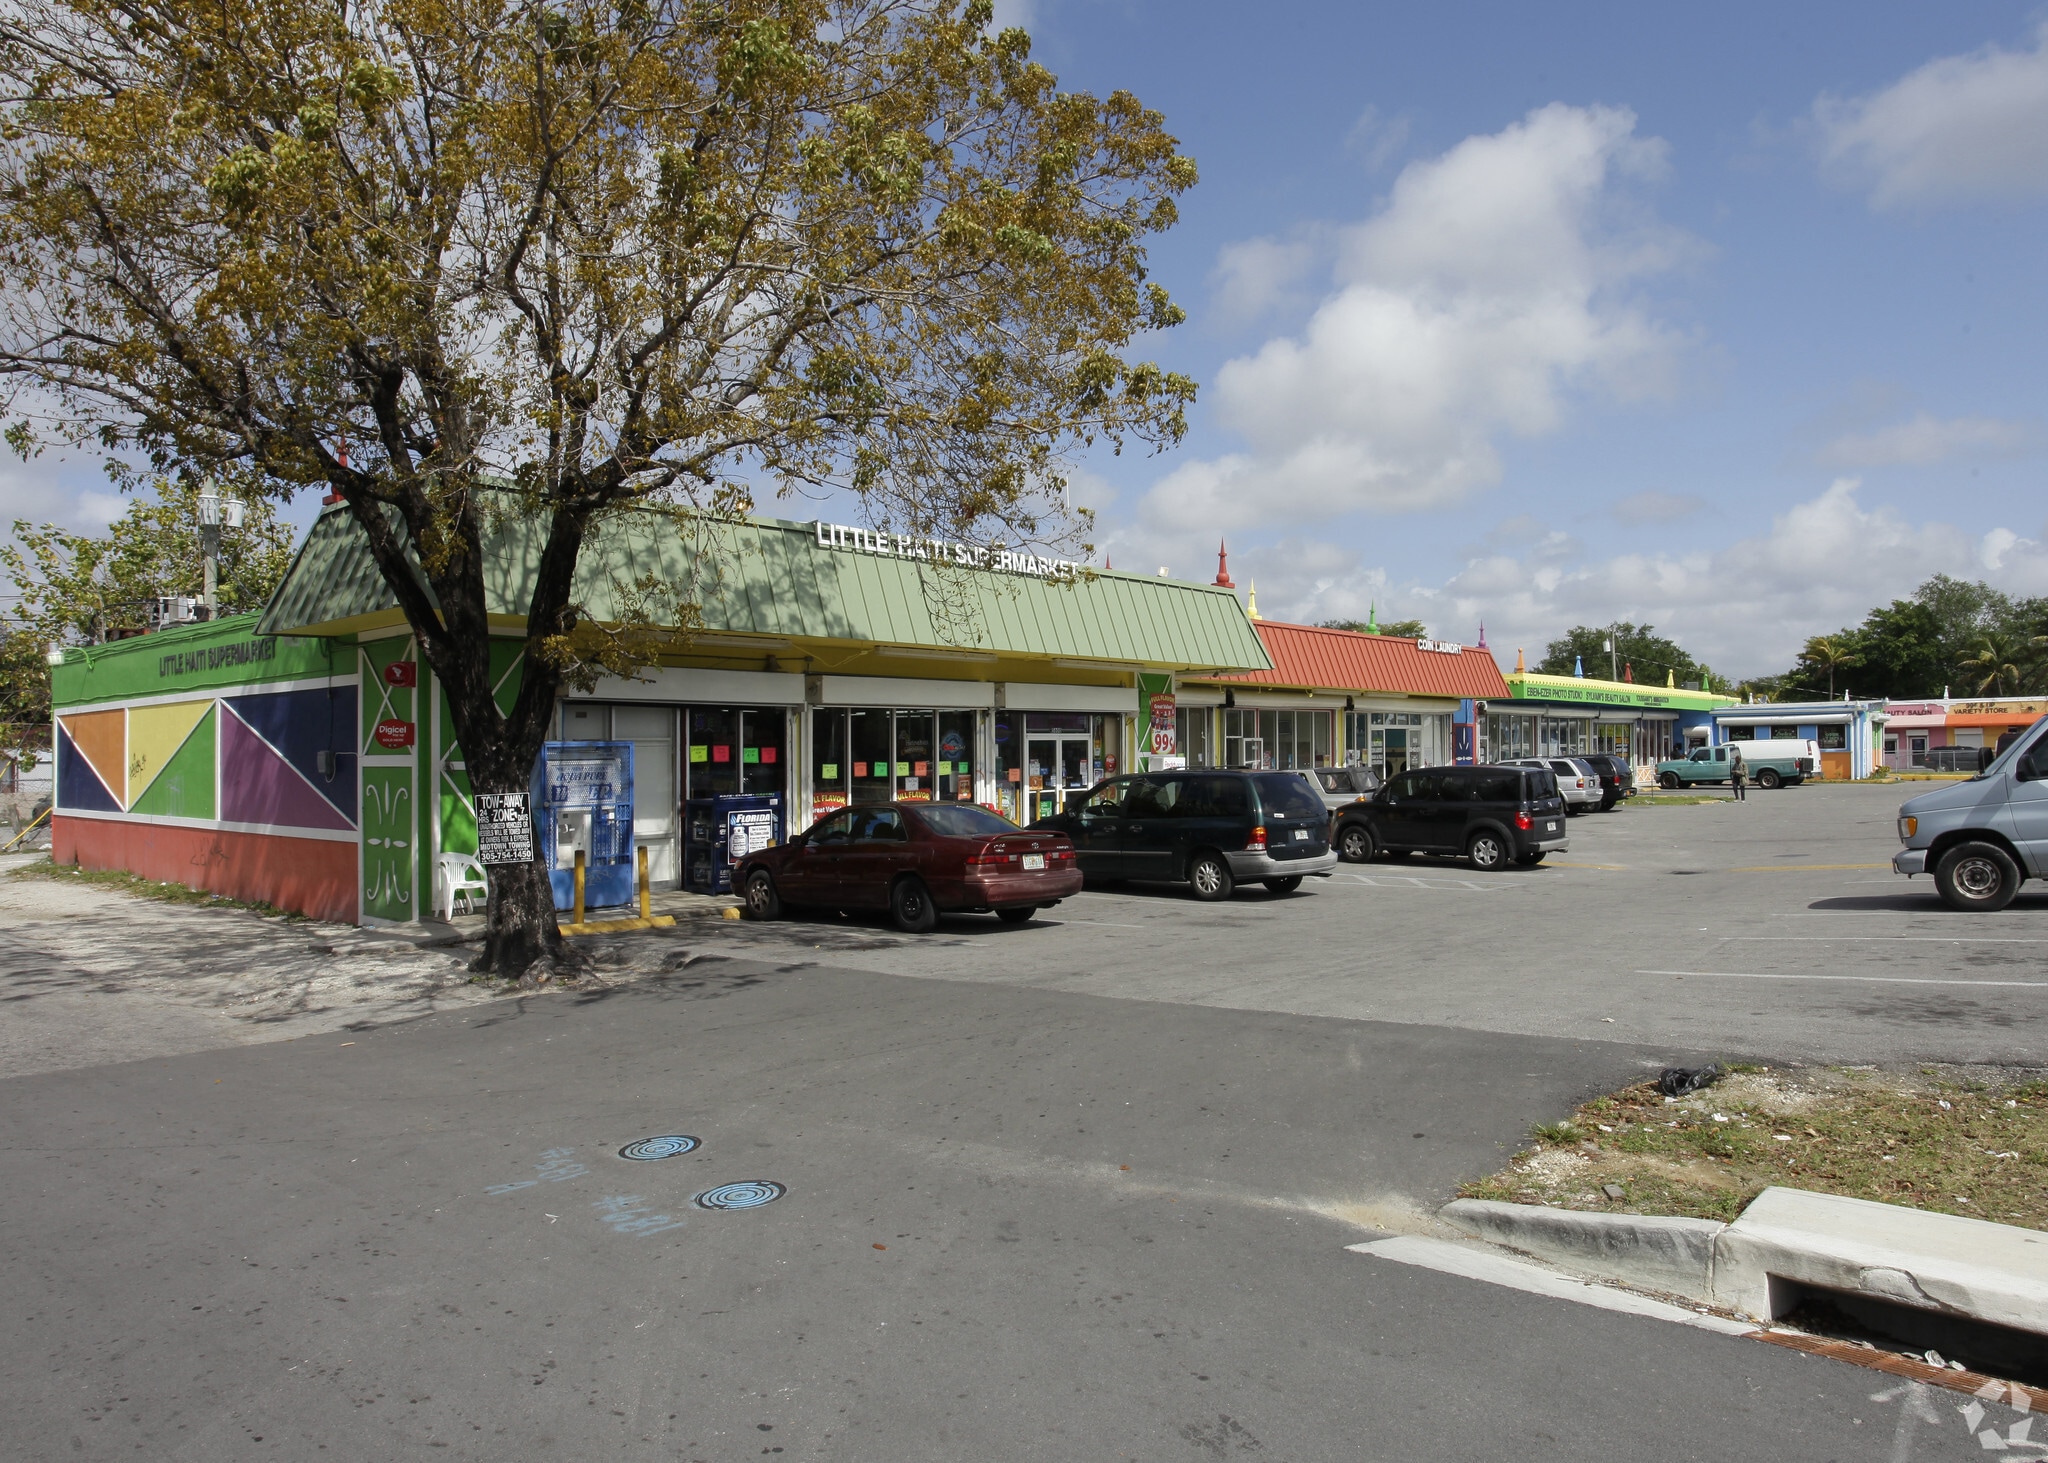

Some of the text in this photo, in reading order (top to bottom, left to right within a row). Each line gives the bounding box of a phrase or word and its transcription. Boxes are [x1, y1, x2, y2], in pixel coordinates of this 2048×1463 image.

[816, 521, 1079, 577] LITTLE HAITI SUPERMARKET
[1417, 639, 1462, 655] COIN LAUNDRY
[159, 636, 278, 678] LITTLE HAITI SUPERMARKET
[1527, 687, 1582, 700] EBEN-EZER PHOTO STUDIO
[1604, 694, 1619, 704] BEAUTY
[1619, 695, 1631, 704] SALON
[379, 725, 407, 735] Digicel
[1155, 733, 1174, 751] 99¢
[822, 794, 846, 805] FLAVOR
[897, 791, 930, 800] ULL FLAVOR
[481, 794, 524, 809] TOW-AWAY
[479, 809, 488, 817] 24
[735, 813, 770, 823] FLORIDA
[506, 821, 522, 829] VEHICLES
[480, 843, 507, 851] MIDTOWN
[508, 841, 531, 849] TOWING
[481, 850, 531, 860] 305-754-1450
